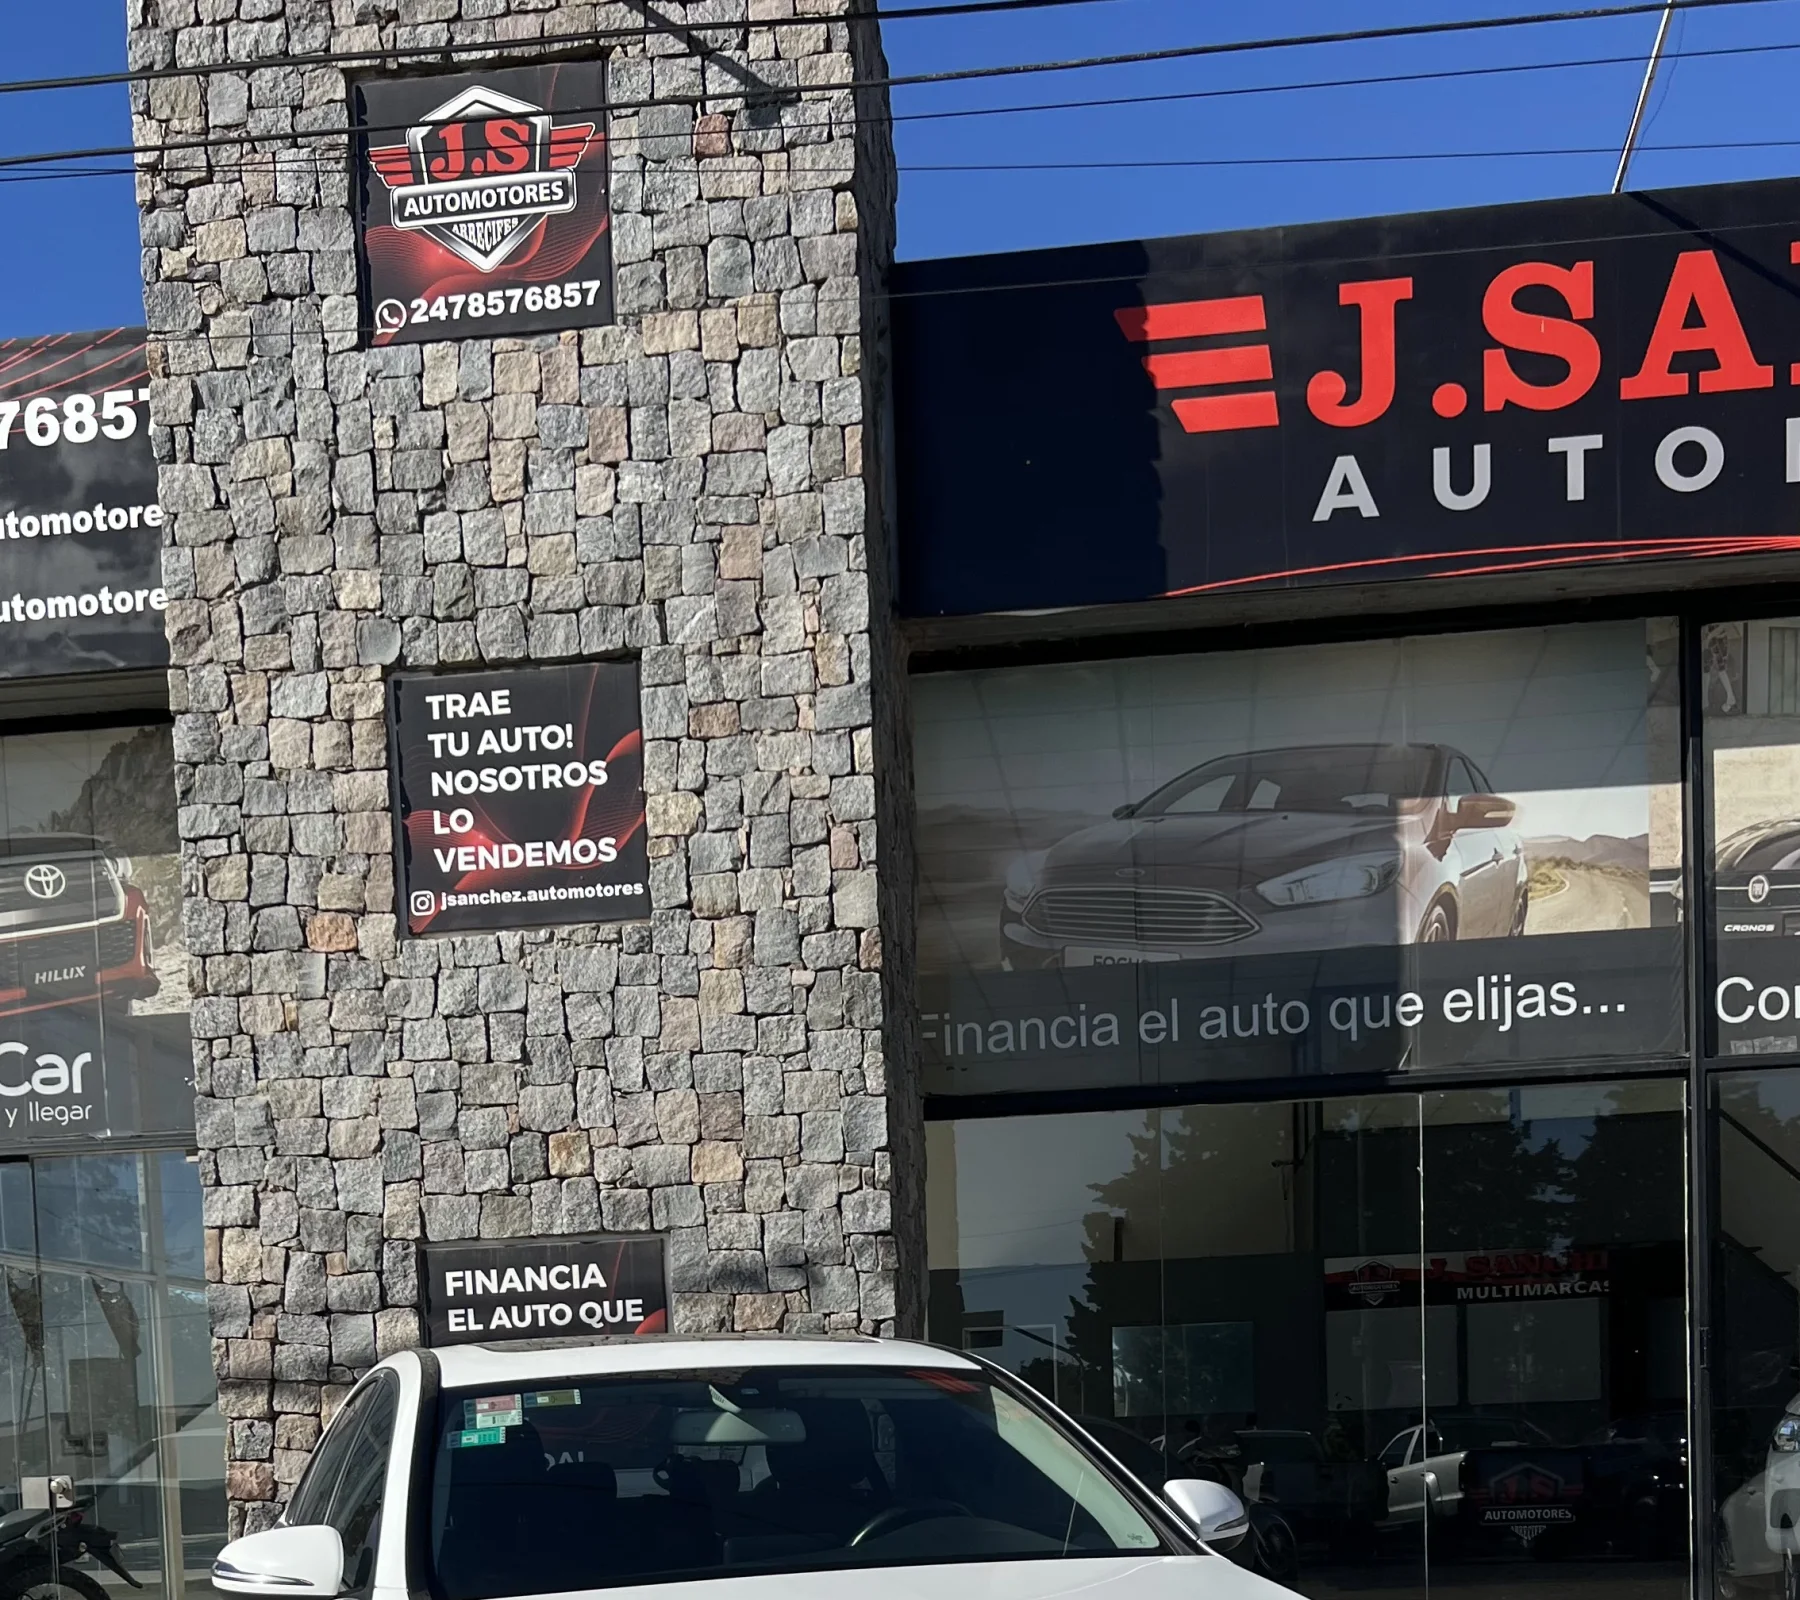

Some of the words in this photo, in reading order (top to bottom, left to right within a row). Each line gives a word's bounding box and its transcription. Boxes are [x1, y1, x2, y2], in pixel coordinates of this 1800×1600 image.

[430, 118, 530, 180] J.S
[404, 181, 564, 217] AUTOMOTORES
[451, 217, 519, 252] ARRECIFES
[410, 280, 601, 324] 2478576857
[1306, 241, 1800, 427] J.SA
[1312, 417, 1800, 522] AUTO
[425, 689, 511, 720] TRAE
[427, 732, 470, 758] TU
[477, 724, 574, 755] AUTO!
[431, 760, 608, 796] NOSOTROS
[433, 808, 474, 835] LO
[434, 837, 617, 873] VENDEMOS
[440, 883, 644, 911] jsanchez.automotores
[1724, 924, 1775, 932] CRONOS
[34, 966, 86, 984] HILUX
[1139, 998, 1179, 1043] el
[1199, 993, 1310, 1040] auto
[1329, 992, 1424, 1041] que
[1443, 973, 1626, 1032] elijas...
[1715, 976, 1800, 1024] Co
[0, 1041, 92, 1097] Car
[5, 1108, 17, 1128] y
[29, 1101, 92, 1126] llegar
[445, 1263, 607, 1297] FINANCIA
[448, 1307, 483, 1332] EL
[490, 1303, 573, 1329] AUTO
[579, 1298, 645, 1328] QUE
[1484, 1508, 1572, 1521] AUTOMOTORES
